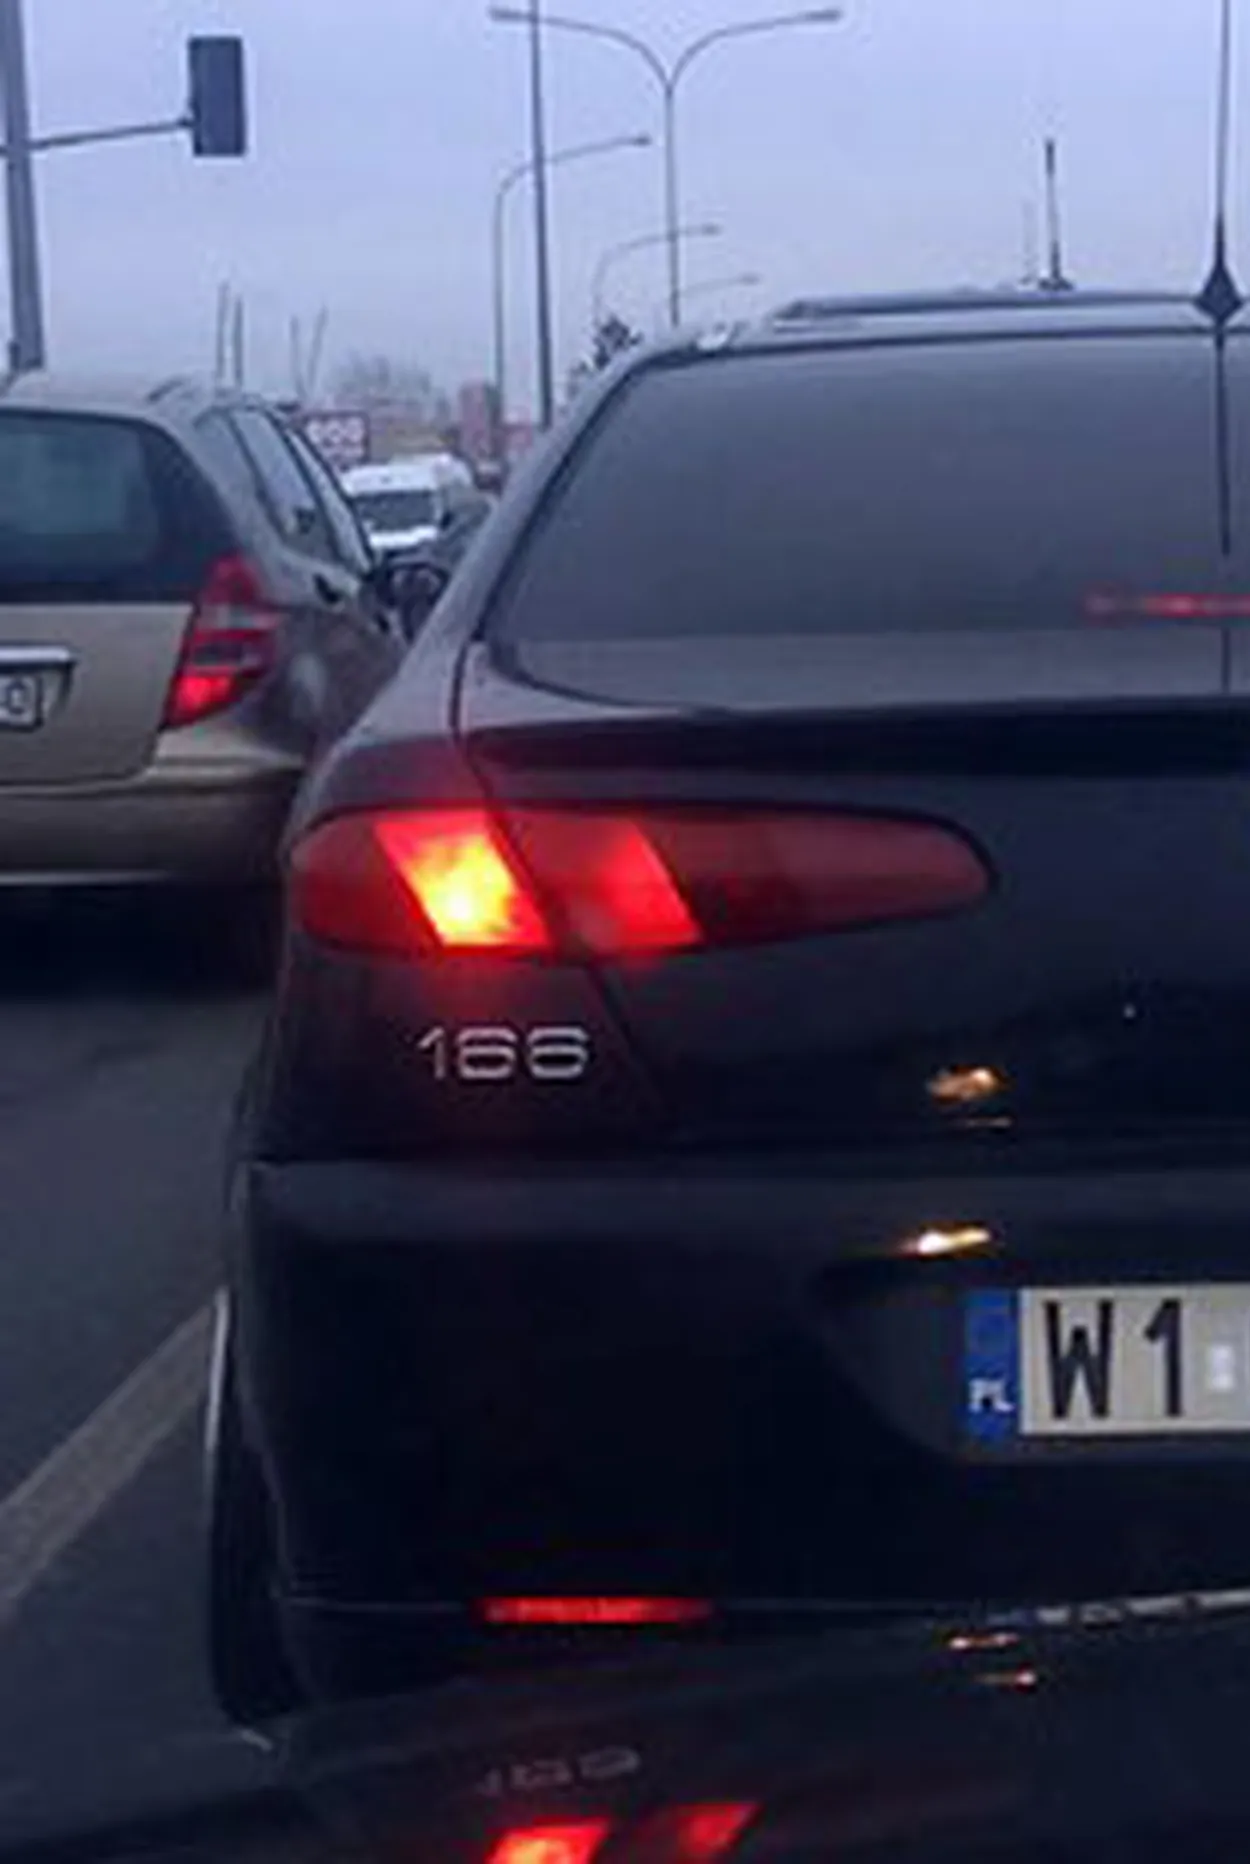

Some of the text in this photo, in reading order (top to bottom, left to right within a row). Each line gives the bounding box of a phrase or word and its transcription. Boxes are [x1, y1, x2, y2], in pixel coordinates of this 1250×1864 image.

[418, 1026, 589, 1079] 166
[1044, 1297, 1183, 1419] W1
[970, 1379, 1015, 1413] PL
